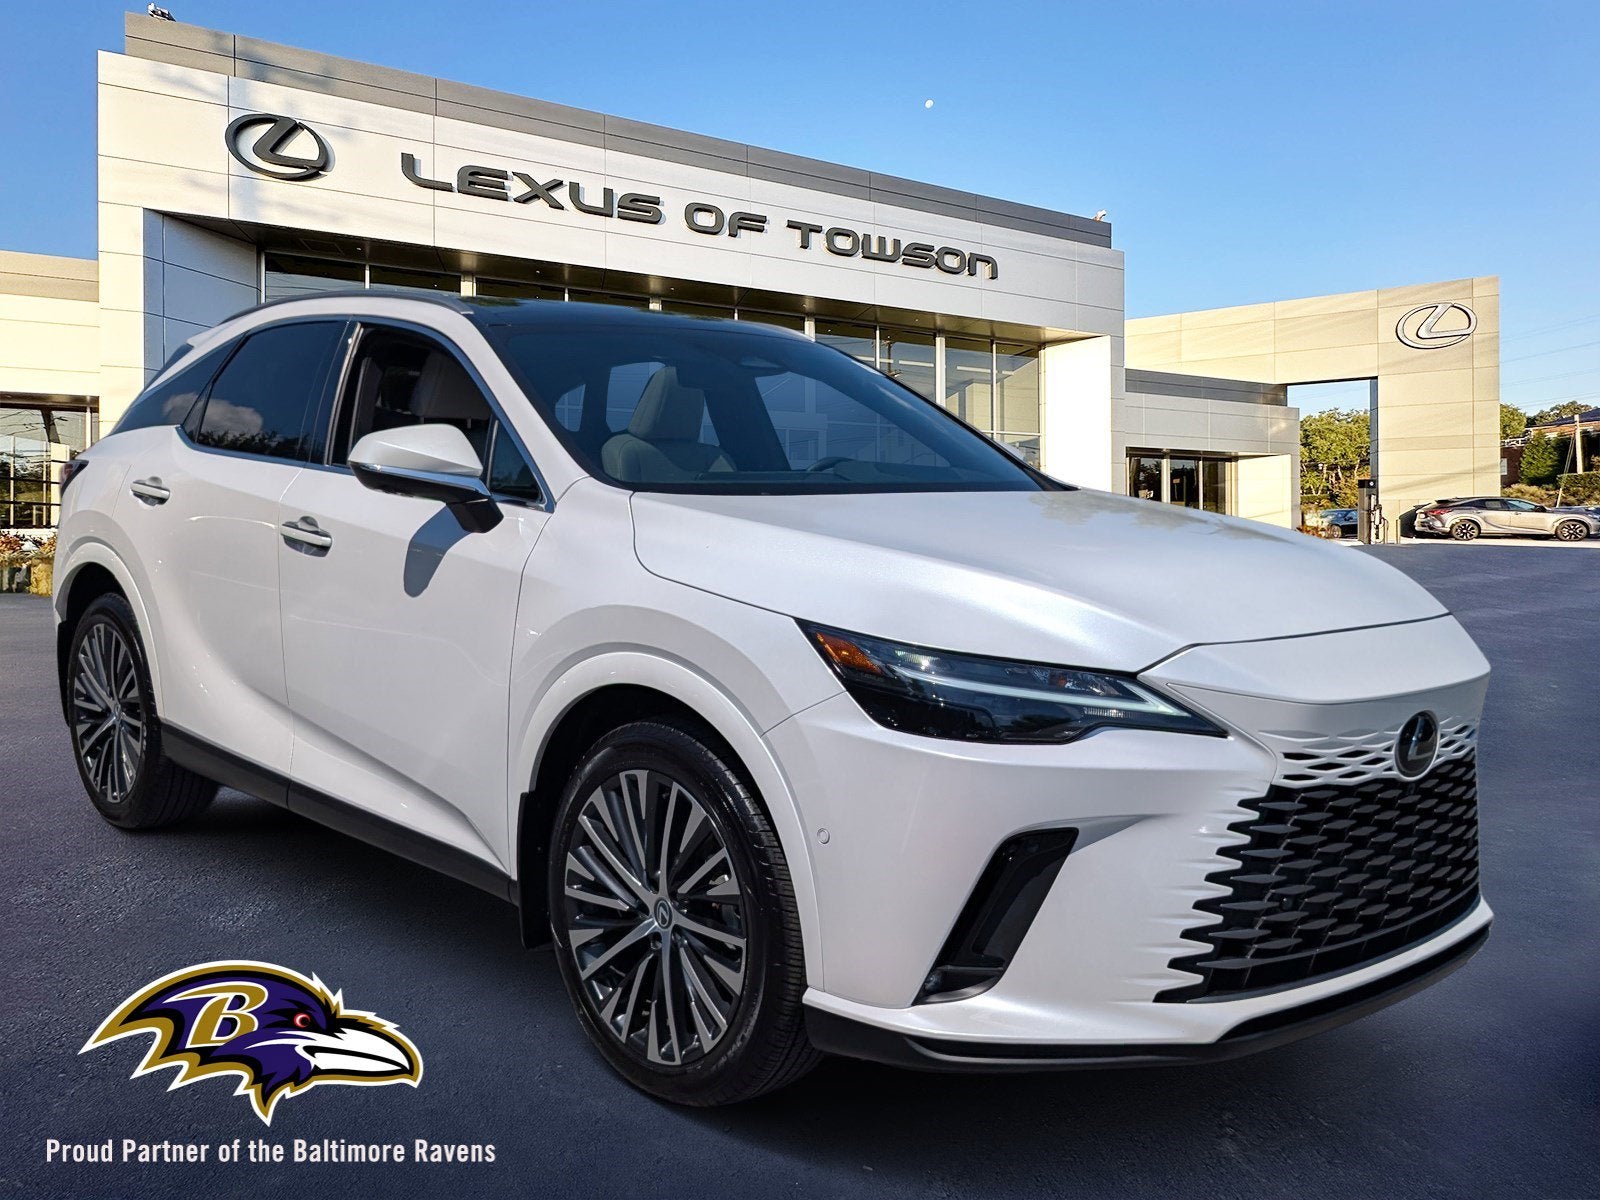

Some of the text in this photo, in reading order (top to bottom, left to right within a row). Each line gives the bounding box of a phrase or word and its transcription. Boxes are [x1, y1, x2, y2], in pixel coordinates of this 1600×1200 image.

[401, 152, 999, 280] LEXUS OF TOWSON
